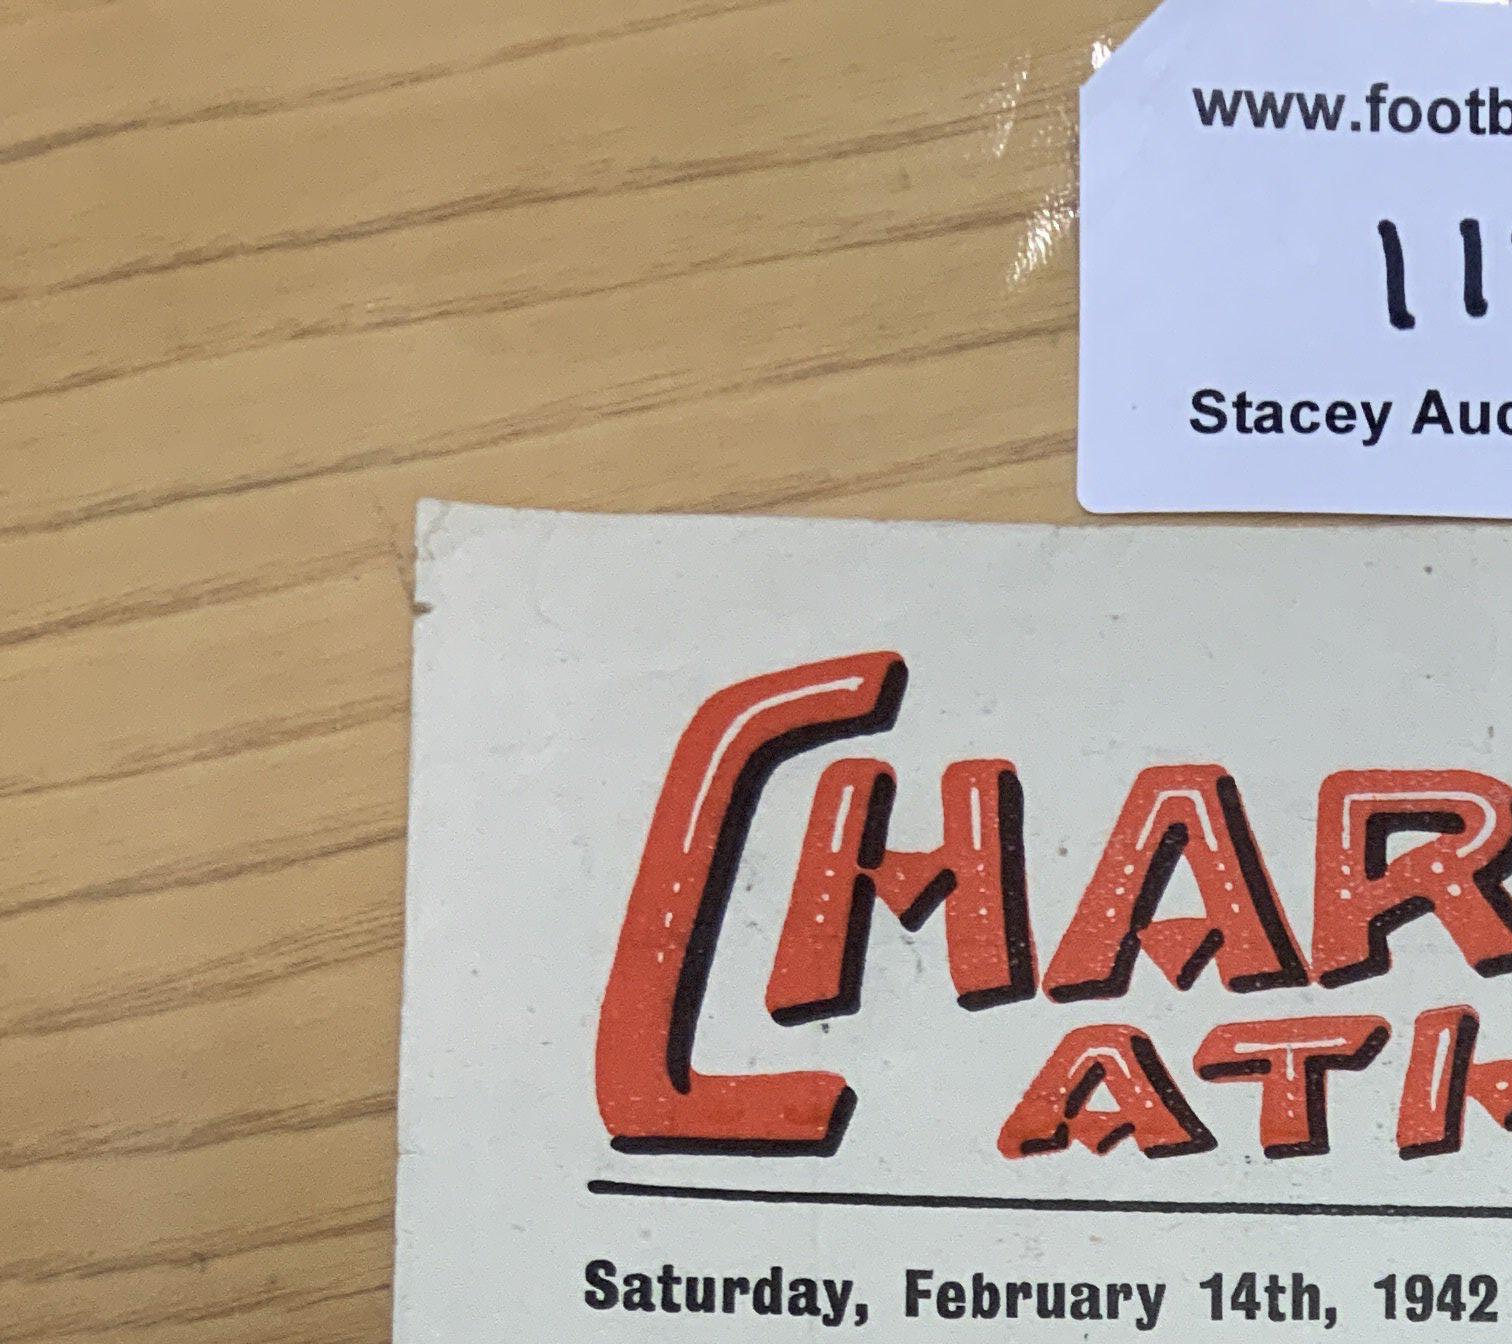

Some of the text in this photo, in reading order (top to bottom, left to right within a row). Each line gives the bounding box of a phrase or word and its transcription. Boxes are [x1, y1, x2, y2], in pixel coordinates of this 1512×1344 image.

[1190, 389, 1392, 447] Stacey
[584, 1259, 1498, 1331] Saturday, February 14th, 1942
